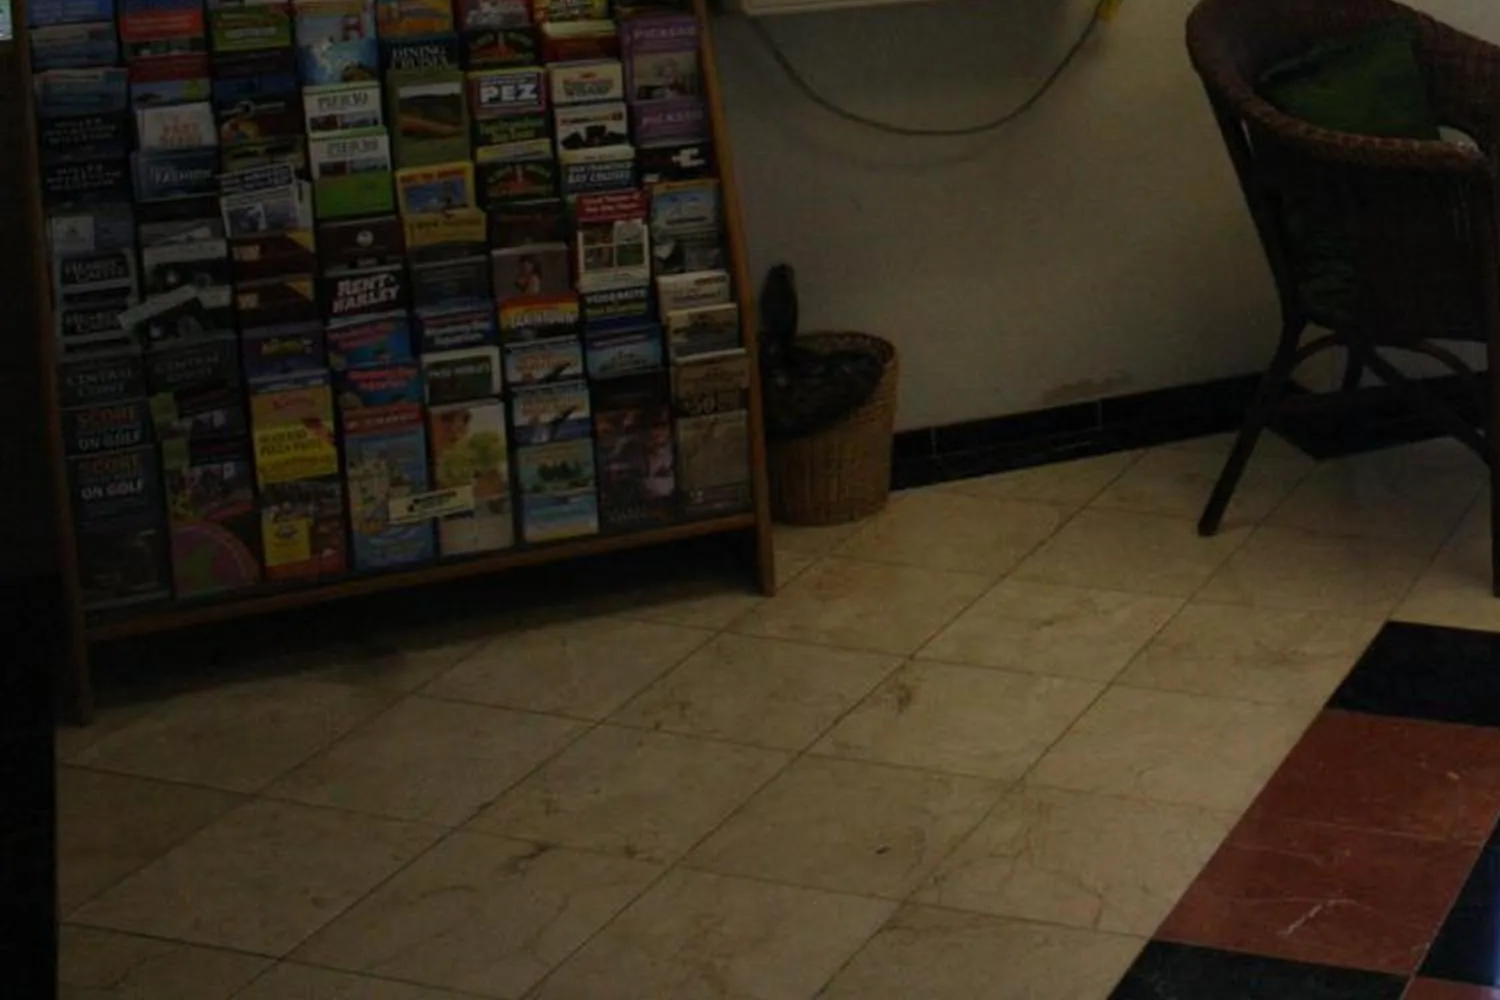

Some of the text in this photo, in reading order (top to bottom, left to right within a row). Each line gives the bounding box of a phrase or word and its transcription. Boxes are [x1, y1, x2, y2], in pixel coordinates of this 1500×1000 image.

[480, 84, 539, 104] PEZ
[80, 478, 144, 501] ON GOLF
